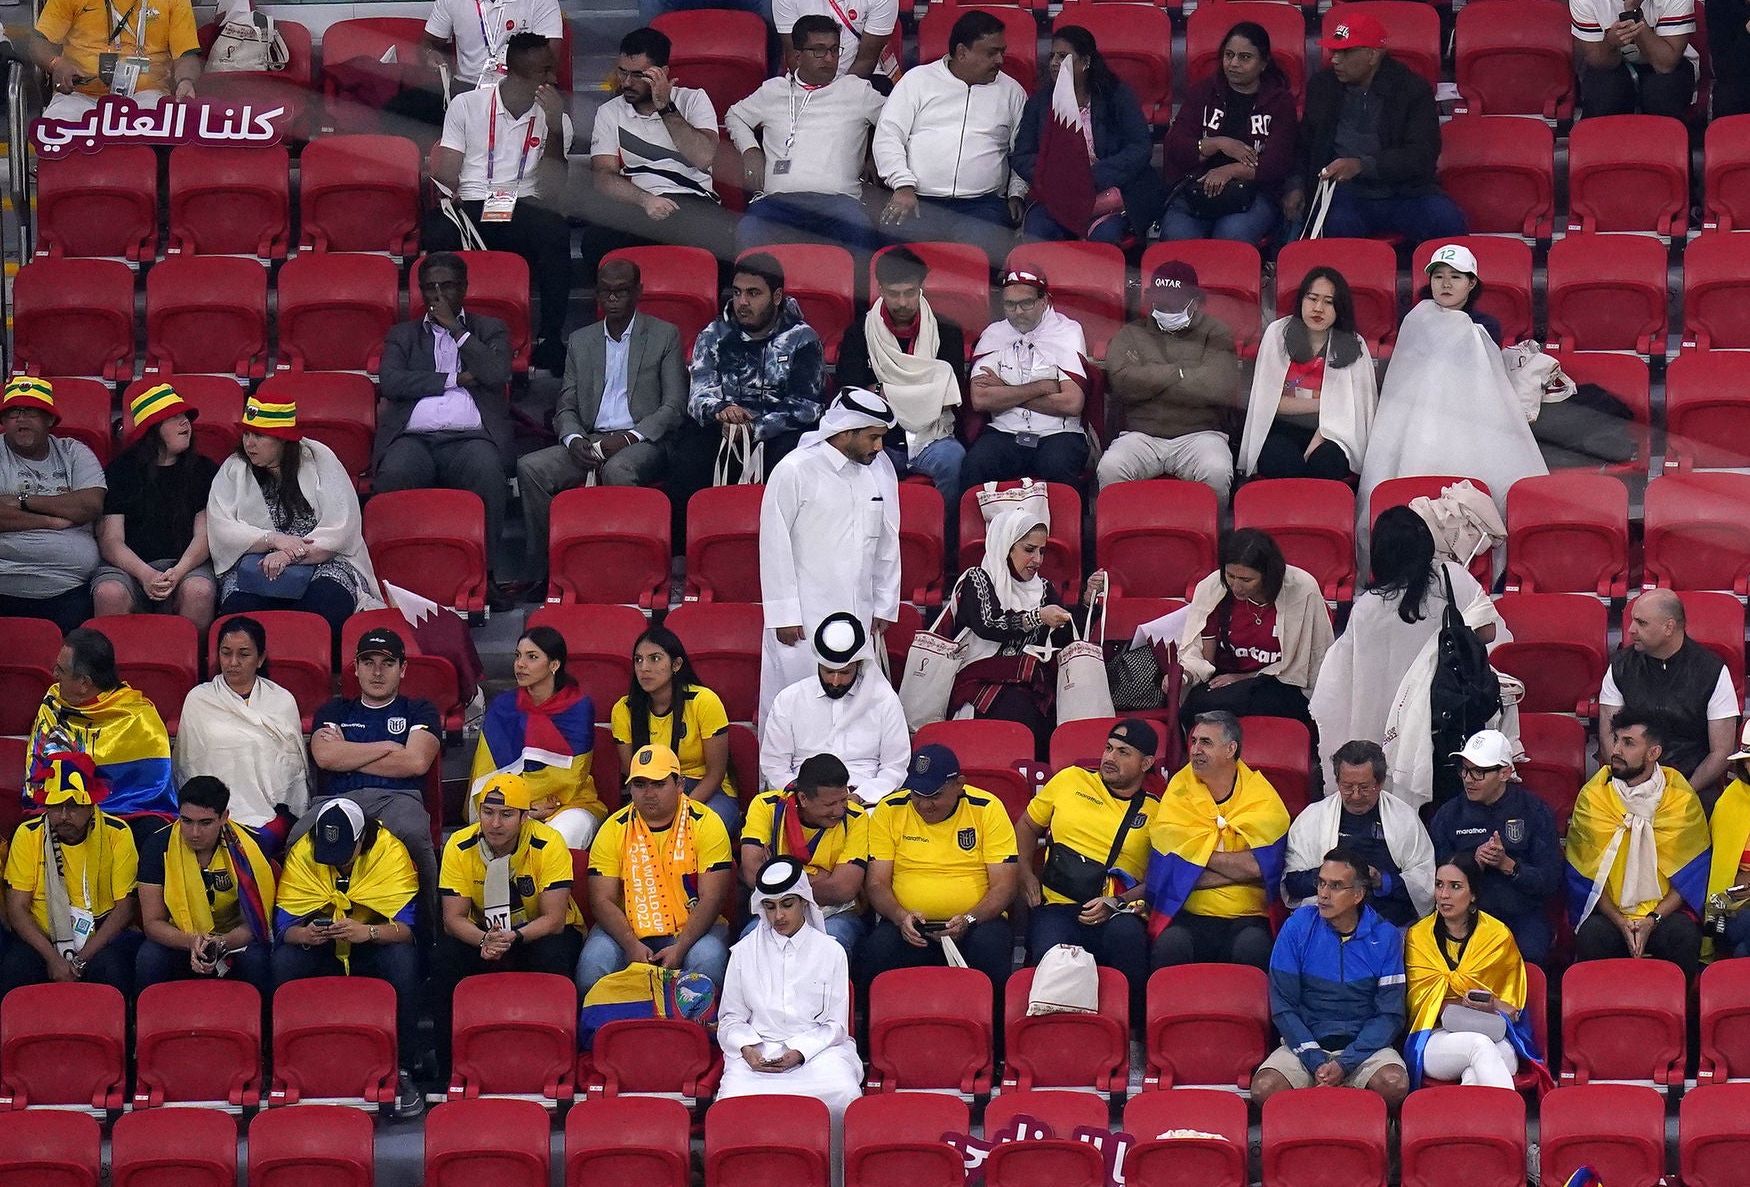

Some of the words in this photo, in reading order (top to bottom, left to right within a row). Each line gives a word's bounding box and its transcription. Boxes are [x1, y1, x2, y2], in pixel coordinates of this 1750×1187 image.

[36, 102, 187, 152] العنابي
[199, 103, 285, 141] كلنا
[1440, 249, 1456, 261] 12
[1155, 277, 1182, 289] QATAR
[1074, 790, 1105, 806] marathon
[1455, 826, 1488, 836] marathon
[643, 865, 660, 911] WORLD
[651, 910, 664, 933] CUP
